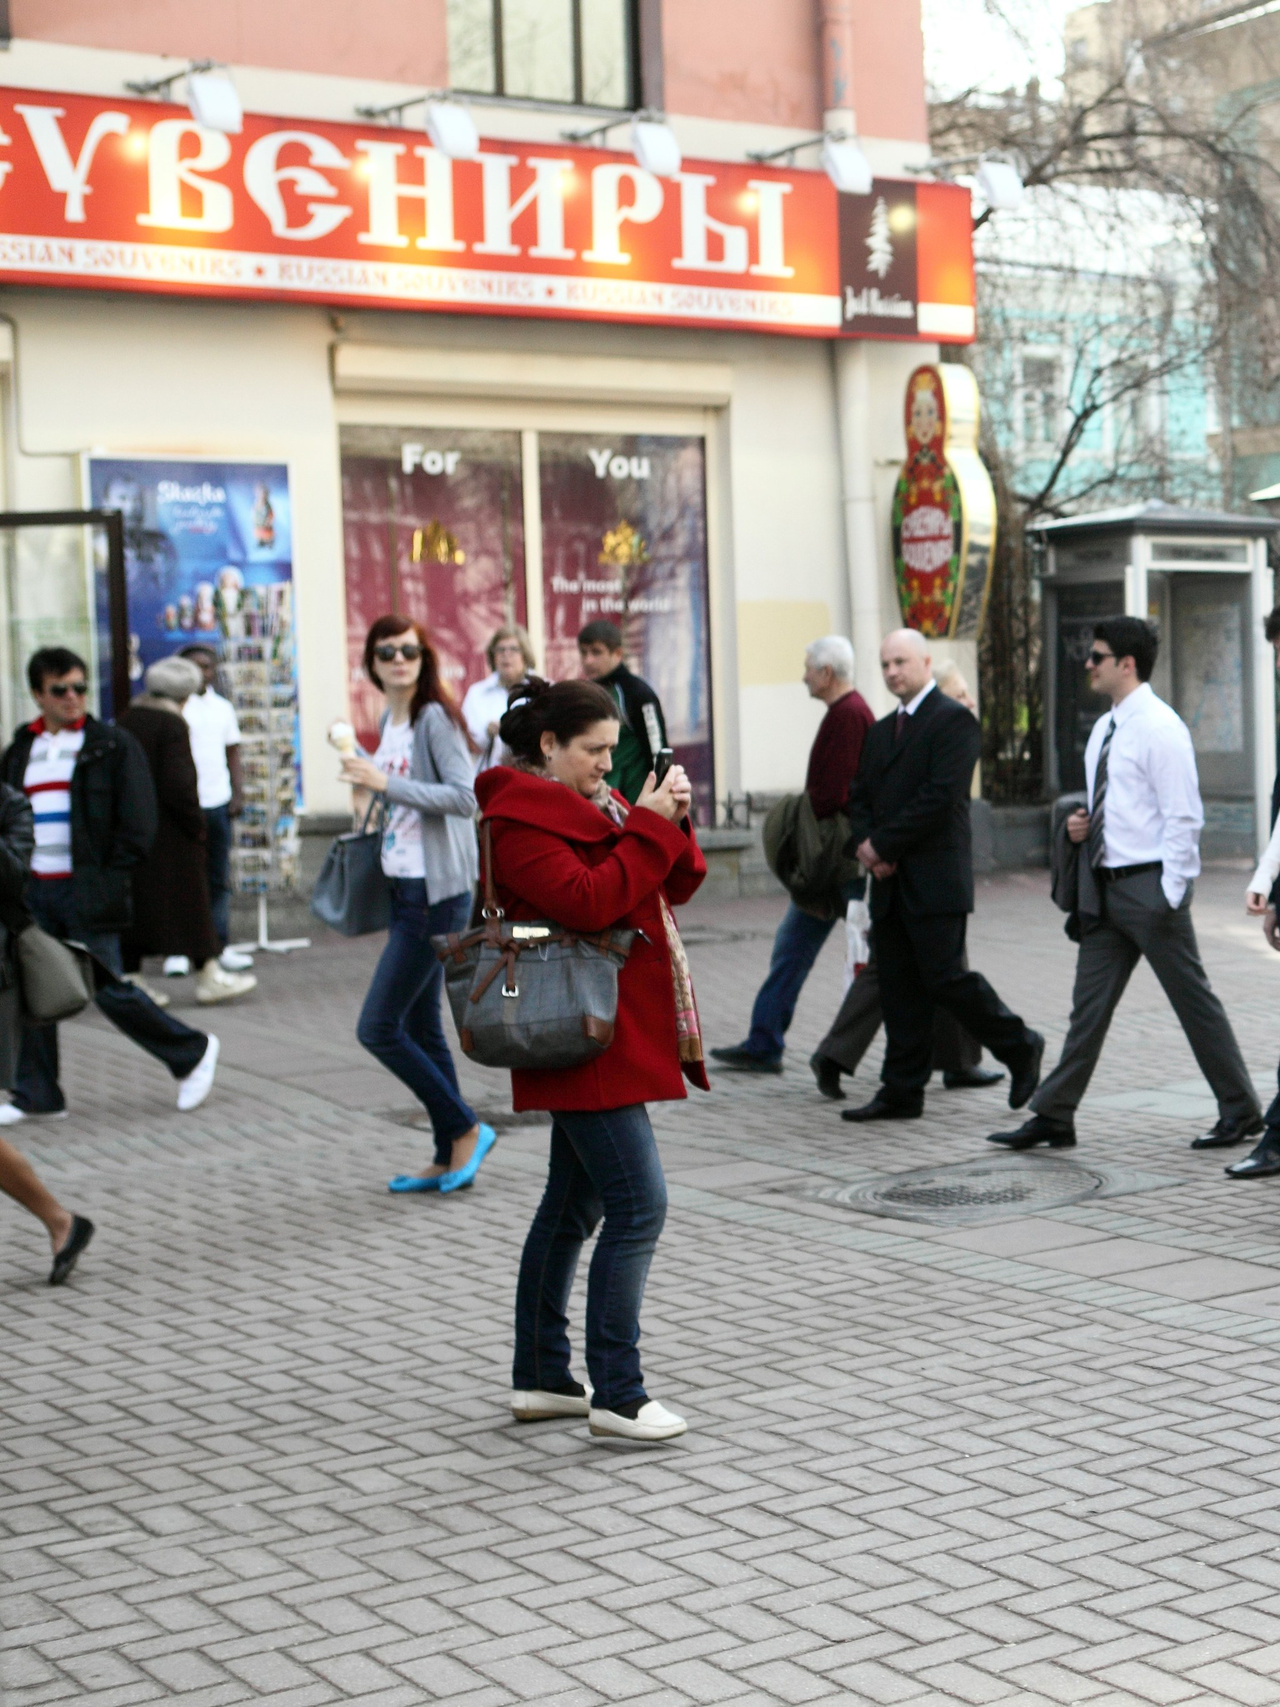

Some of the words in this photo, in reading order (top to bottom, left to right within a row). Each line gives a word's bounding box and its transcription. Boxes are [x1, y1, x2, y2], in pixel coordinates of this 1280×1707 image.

[401, 443, 461, 476] For
[589, 448, 650, 479] You
[551, 576, 579, 594] The
[582, 578, 622, 594] most
[600, 596, 624, 613] the
